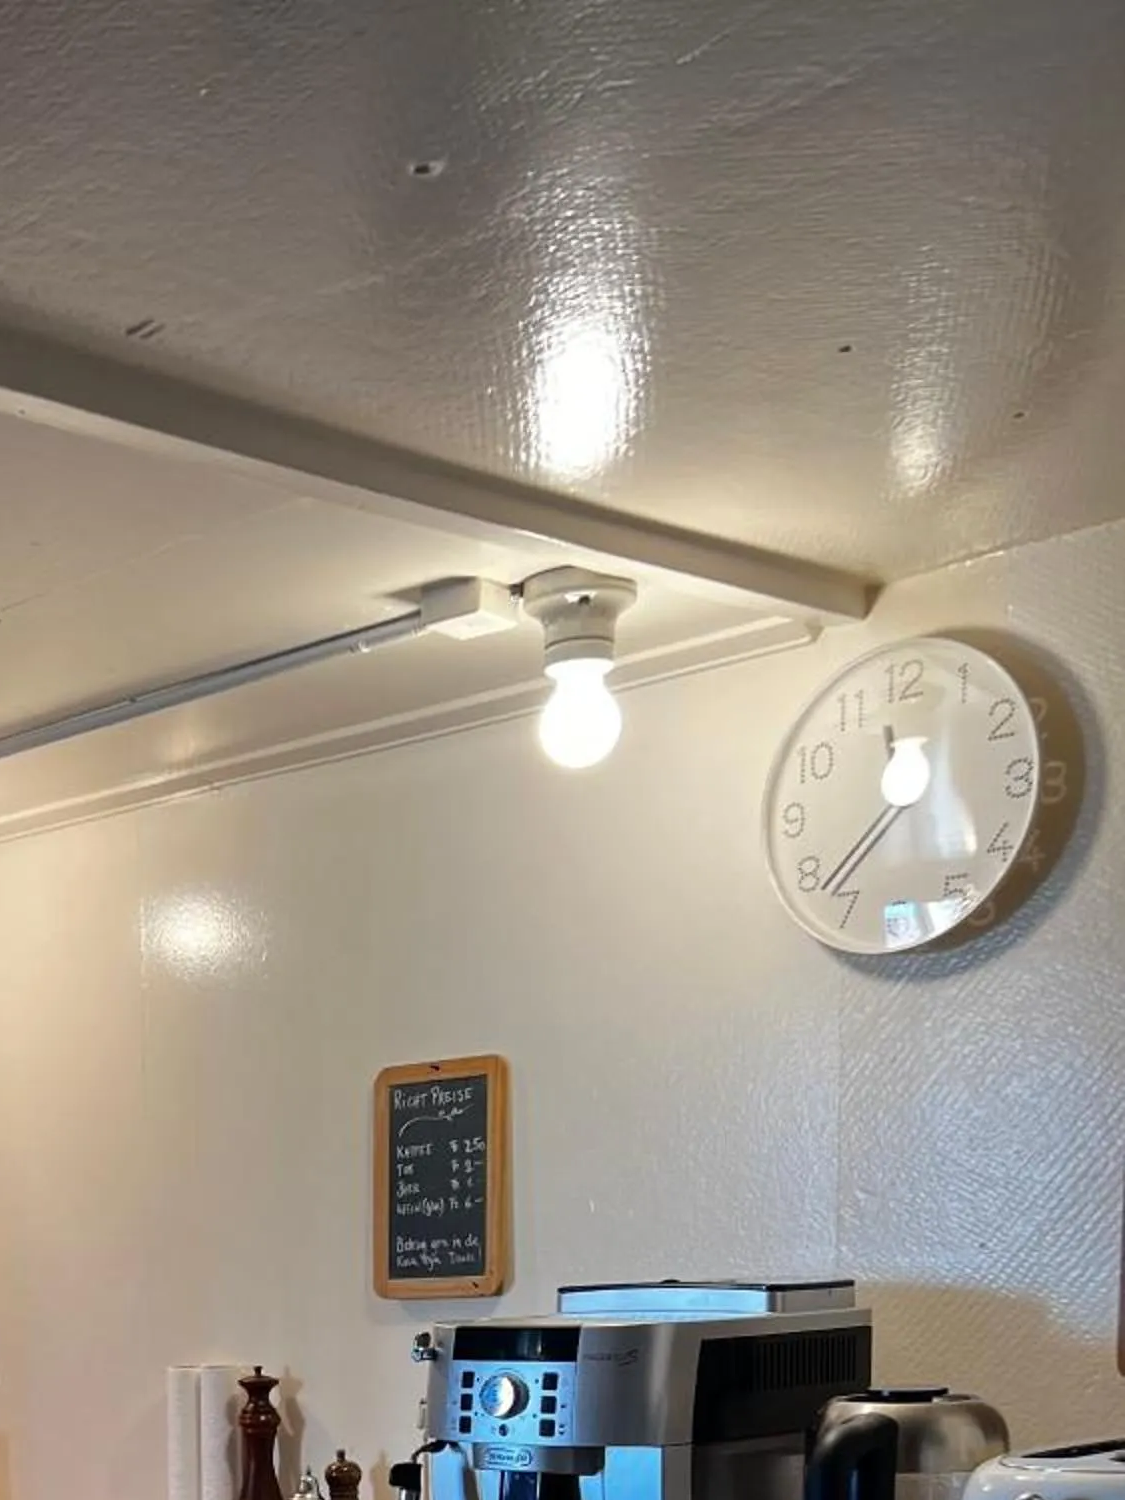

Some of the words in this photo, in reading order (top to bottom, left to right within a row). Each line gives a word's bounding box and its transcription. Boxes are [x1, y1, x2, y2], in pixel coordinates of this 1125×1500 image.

[885, 659, 924, 704] 12
[958, 662, 970, 704] 1
[839, 689, 865, 732] 11
[987, 698, 1019, 742] 2
[800, 741, 834, 784] 10
[1004, 757, 1035, 800] 3
[783, 802, 806, 838] 9
[986, 821, 1014, 863] 4
[797, 855, 821, 893] 8
[836, 889, 860, 930] 7
[431, 1085, 474, 1107] PREISE
